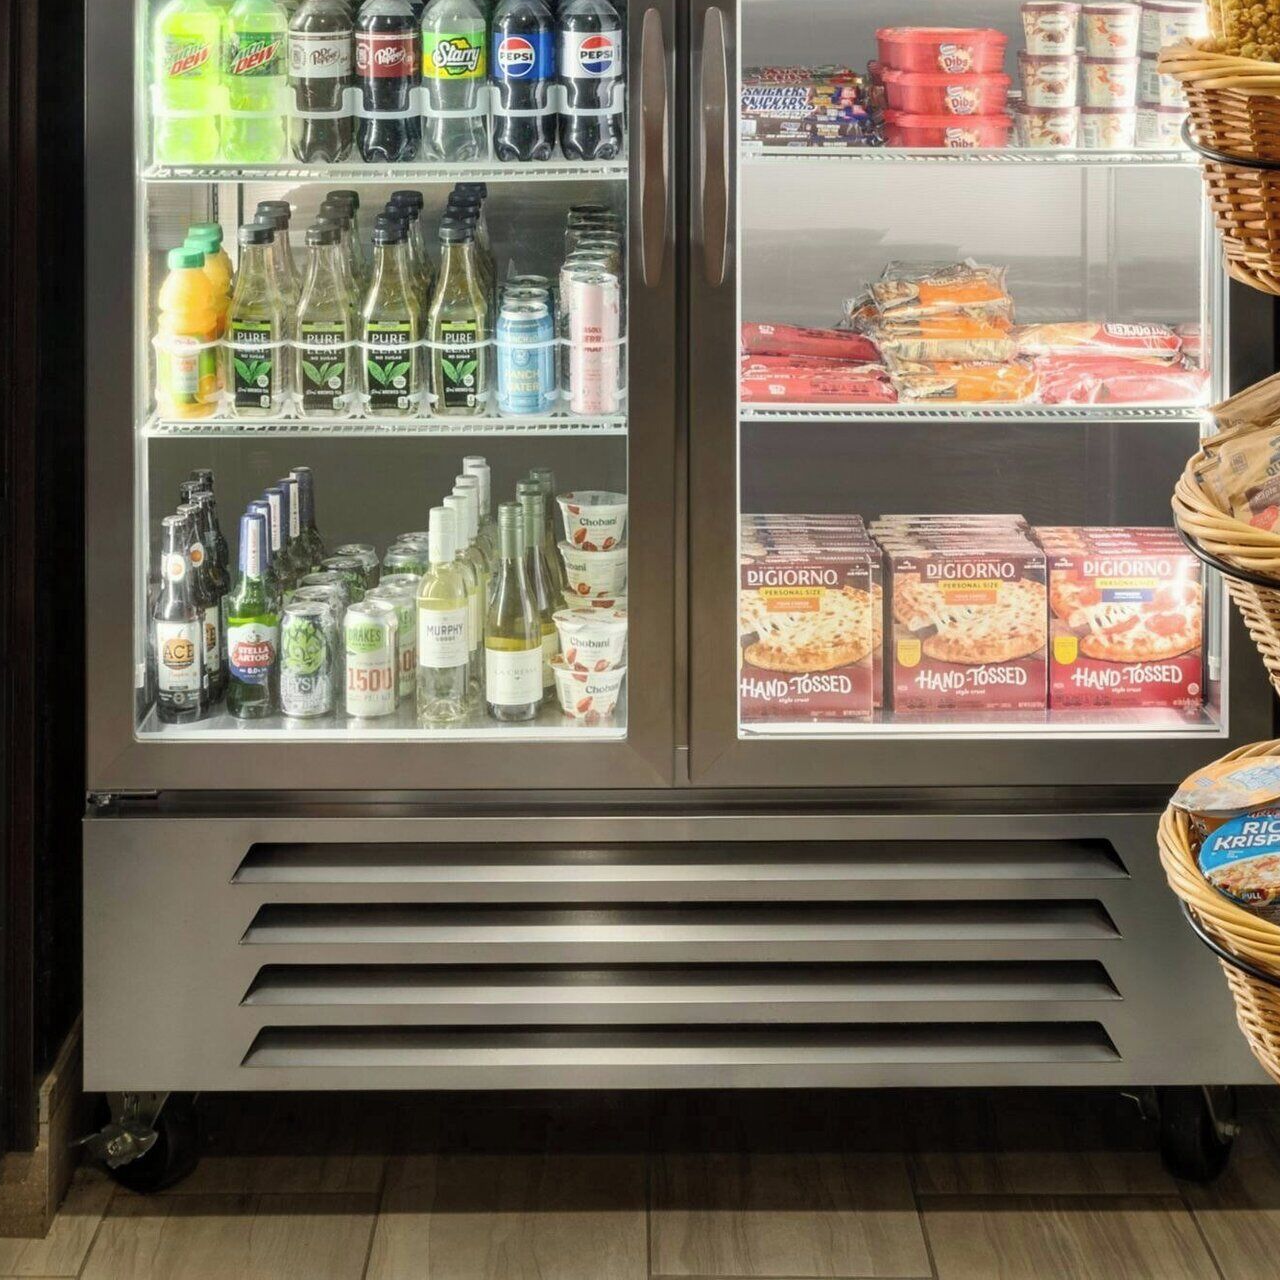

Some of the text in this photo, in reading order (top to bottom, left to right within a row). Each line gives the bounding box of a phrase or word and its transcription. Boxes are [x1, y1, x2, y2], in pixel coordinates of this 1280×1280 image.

[321, 47, 332, 56] Dr
[376, 50, 406, 65] Pepper
[386, 47, 397, 56] Dr
[434, 40, 481, 69] Starry
[500, 52, 533, 62] PEPSI
[580, 51, 613, 60] PEPSI
[310, 51, 339, 65] Pepper
[943, 56, 969, 69] Dibs
[951, 97, 975, 109] Dibs
[237, 332, 268, 344] PURE
[306, 333, 341, 345] PURE
[371, 333, 406, 344] PURE
[445, 332, 472, 344] PURE
[580, 516, 617, 527] Chobani
[943, 581, 999, 589] PERSONAL SIZE
[765, 588, 821, 597] PERSONAL SIZE
[426, 623, 464, 637] MURPHY
[570, 637, 610, 649] Chobani
[163, 644, 196, 660] ACE
[238, 646, 270, 655] STELLA
[237, 653, 270, 663] ARTOIS
[348, 669, 393, 693] 1500
[915, 665, 1027, 691] HAND-TOSSED
[1071, 664, 1182, 690] HAND-TOSSED
[741, 674, 852, 700] HAND-TOSSED
[778, 696, 810, 705] style crust
